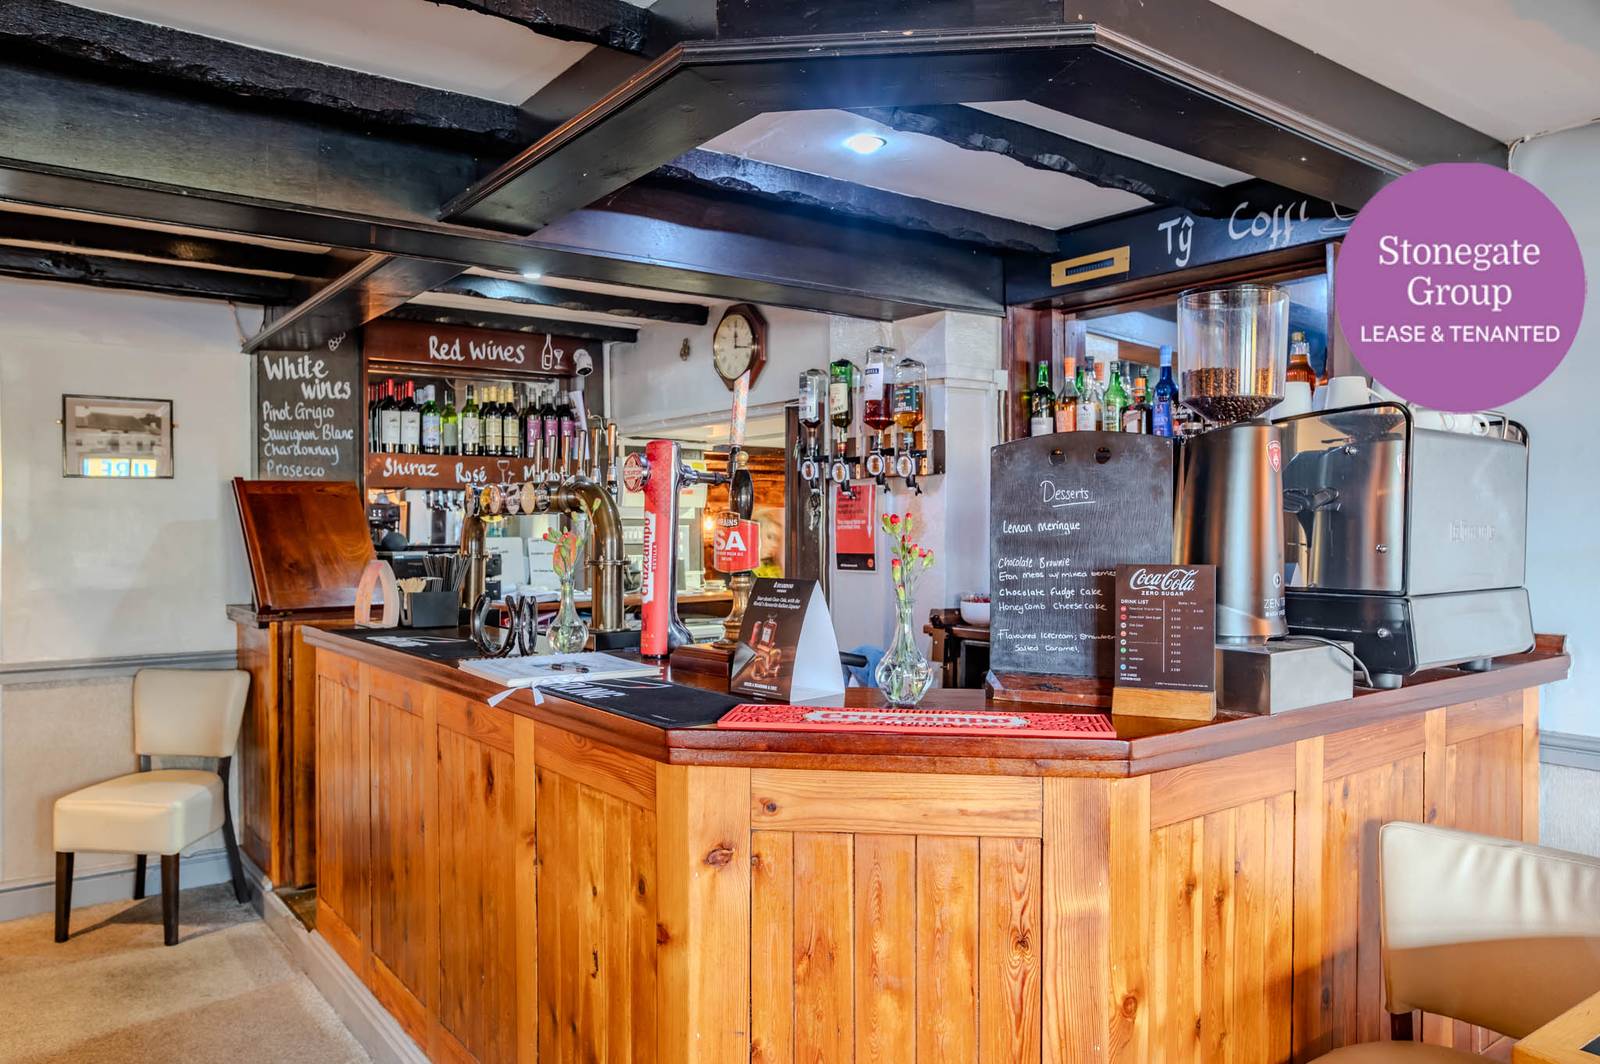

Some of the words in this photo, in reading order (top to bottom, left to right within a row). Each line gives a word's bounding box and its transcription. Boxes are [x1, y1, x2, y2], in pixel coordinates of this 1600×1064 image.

[429, 335, 465, 361] Red
[263, 355, 329, 380] White
[262, 401, 293, 421] Pinot
[295, 402, 335, 428] Grigio
[262, 422, 319, 442] Sauvignon
[322, 424, 354, 441] Blanc
[264, 442, 340, 466] Chardonnay
[267, 459, 325, 477] Prosecco
[383, 457, 439, 478] Shiraz
[455, 462, 488, 483] Rosé
[1040, 480, 1089, 503] Desserts
[714, 529, 747, 551] SA
[998, 556, 1033, 568] Chocolate
[1039, 557, 1071, 569] Brownie
[1130, 568, 1200, 591] Coca-Cola
[999, 588, 1045, 597] Chocolate
[820, 711, 1012, 724] Cruzcampo
